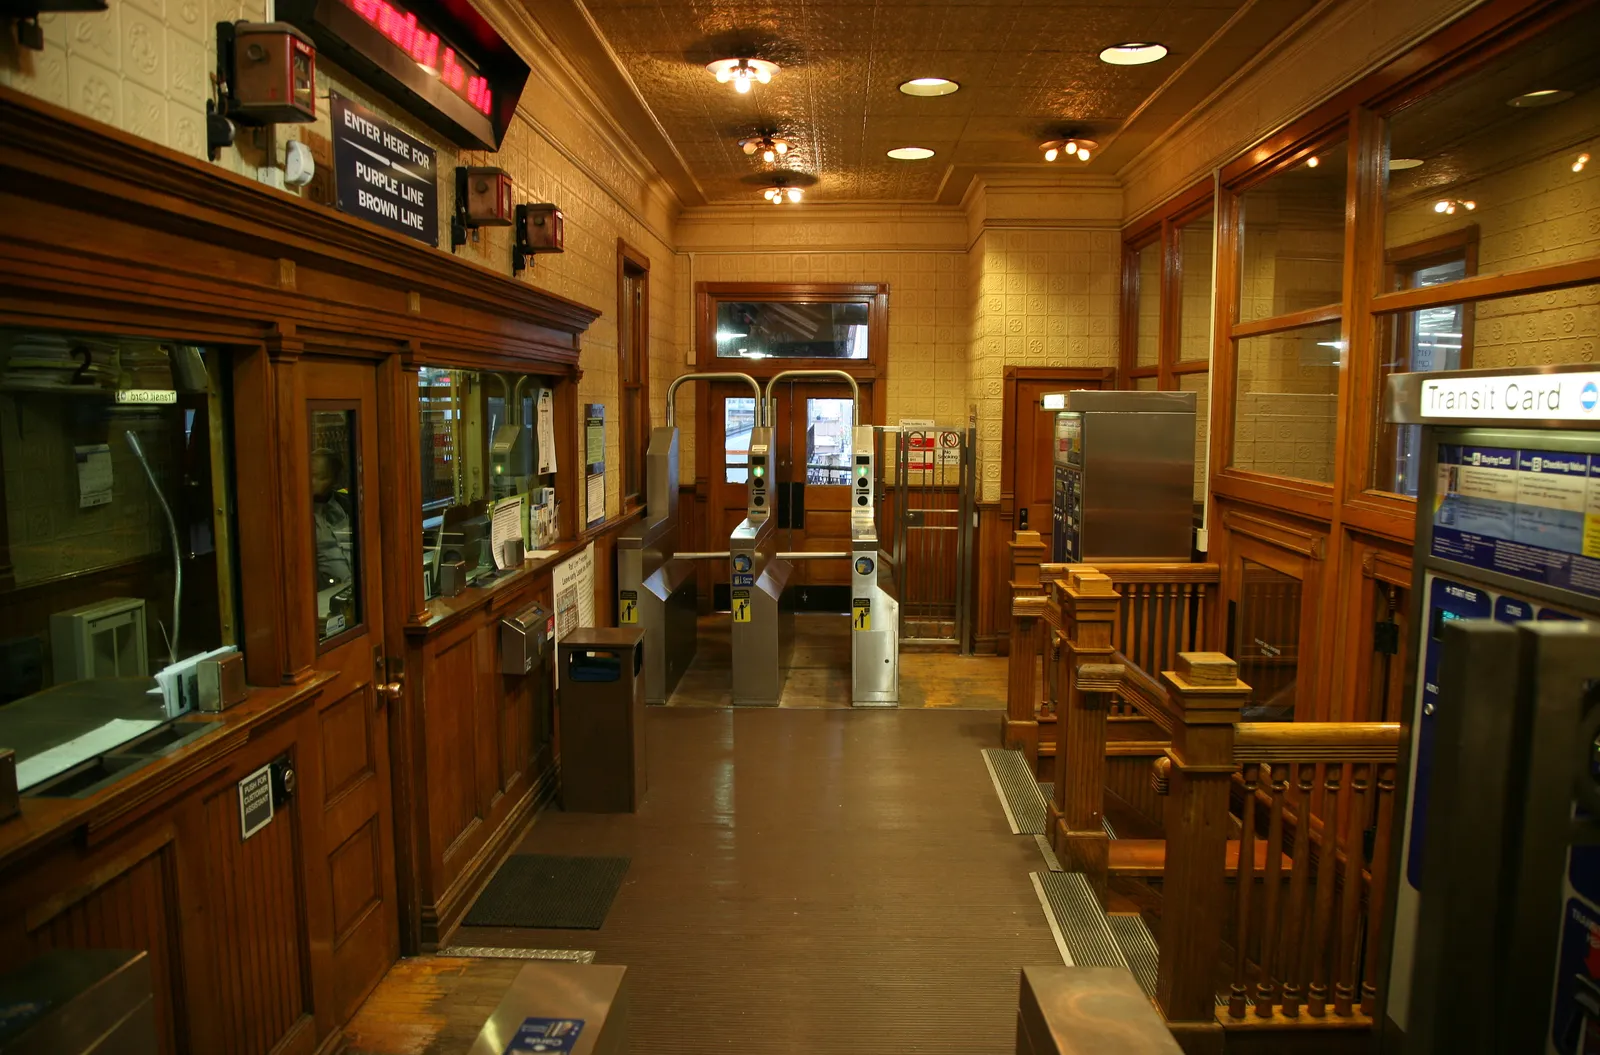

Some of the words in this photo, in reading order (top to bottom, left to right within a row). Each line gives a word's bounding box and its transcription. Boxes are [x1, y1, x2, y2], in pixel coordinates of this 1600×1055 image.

[344, 108, 381, 144] ENTER
[383, 131, 410, 160] HERE
[412, 147, 430, 170] FOR
[355, 160, 399, 196] PURPLE
[401, 183, 425, 207] LINE
[358, 189, 398, 220] BROWN
[401, 207, 424, 231] LINE
[1428, 384, 1496, 410] Transit
[1504, 382, 1562, 411] Card
[244, 781, 258, 795] PUSH
[257, 774, 267, 786] FOR
[244, 784, 269, 805] CUSTOMER
